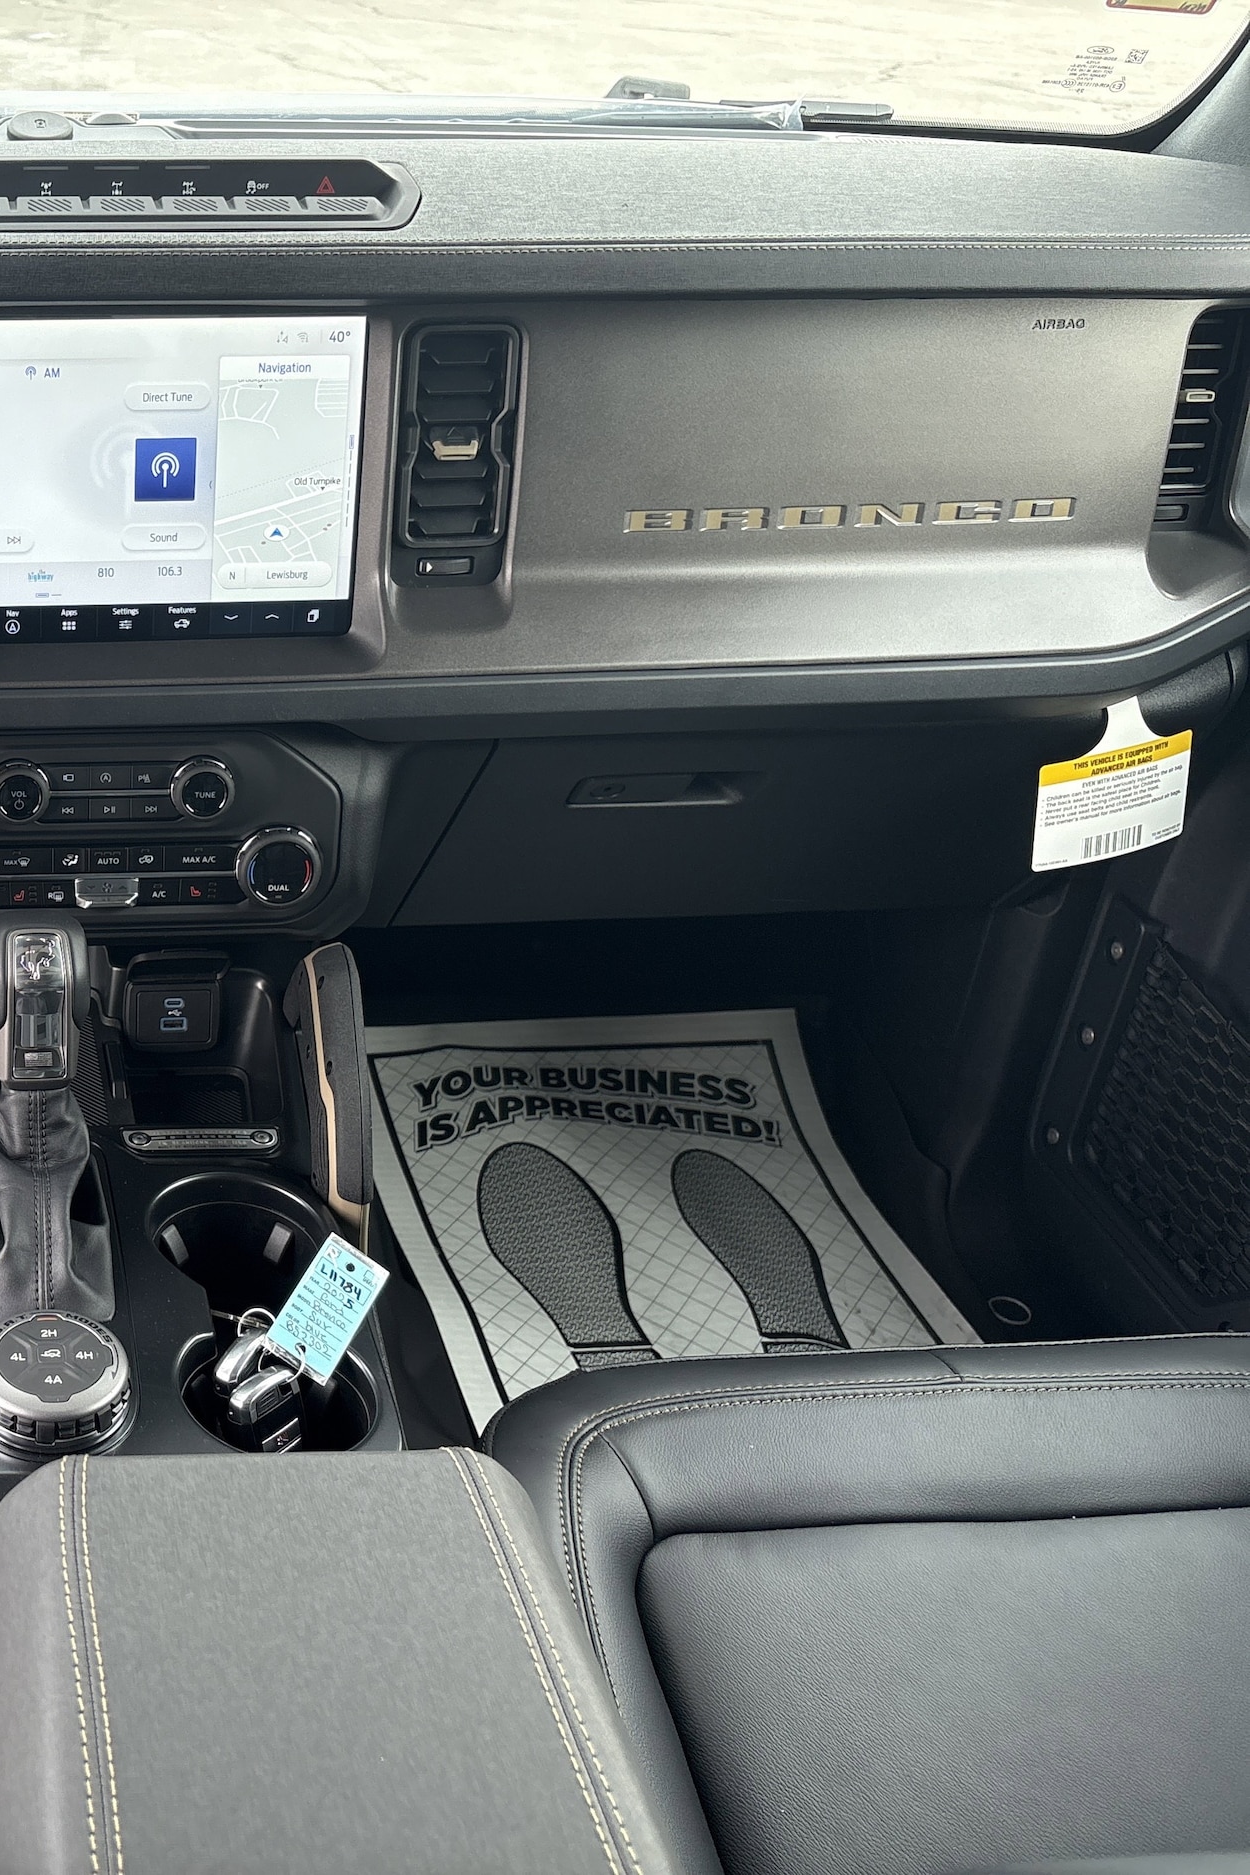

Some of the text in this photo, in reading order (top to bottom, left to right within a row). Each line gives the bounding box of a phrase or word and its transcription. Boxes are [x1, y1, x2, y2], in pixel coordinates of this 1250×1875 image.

[1032, 318, 1085, 330] AIRBAG
[44, 367, 60, 378] AM
[258, 362, 311, 375] Navigation
[142, 392, 193, 402] Direct Tune
[294, 477, 341, 487] Old Turnpike
[622, 496, 1078, 534] BRONCO
[149, 533, 178, 542] Sound
[97, 567, 114, 578] 810
[157, 566, 183, 577] 106.3
[229, 569, 308, 581] N Lewisburg
[6, 609, 20, 618] Nav
[60, 608, 78, 618] Apps
[112, 607, 139, 616] Settings
[168, 606, 197, 615] Features
[1073, 741, 1168, 770] THIS VEHICLE IS EQUIPPED WITH
[1091, 755, 1153, 776] ADVANCED AIR BAGS
[1082, 780, 1096, 788] EVEN
[1111, 770, 1136, 781] ADVANCED
[1046, 793, 1070, 802] Children
[1113, 779, 1136, 788] seriously
[1137, 774, 1153, 782] injured
[11, 790, 27, 798] VOL
[194, 791, 216, 799] TUNE
[97, 857, 120, 865] AUTO
[182, 855, 216, 864] MAX A/C
[267, 884, 290, 892] DUAL
[152, 890, 167, 898] A/C
[413, 1065, 756, 1107] YOUR BUSINESS
[417, 1095, 780, 1149] IS APPRECIATED!
[40, 1329, 58, 1338] 2H
[65, 1312, 113, 1345] MODES
[10, 1352, 26, 1361] 4L
[75, 1350, 94, 1360] 4H
[44, 1375, 63, 1385] 4A
